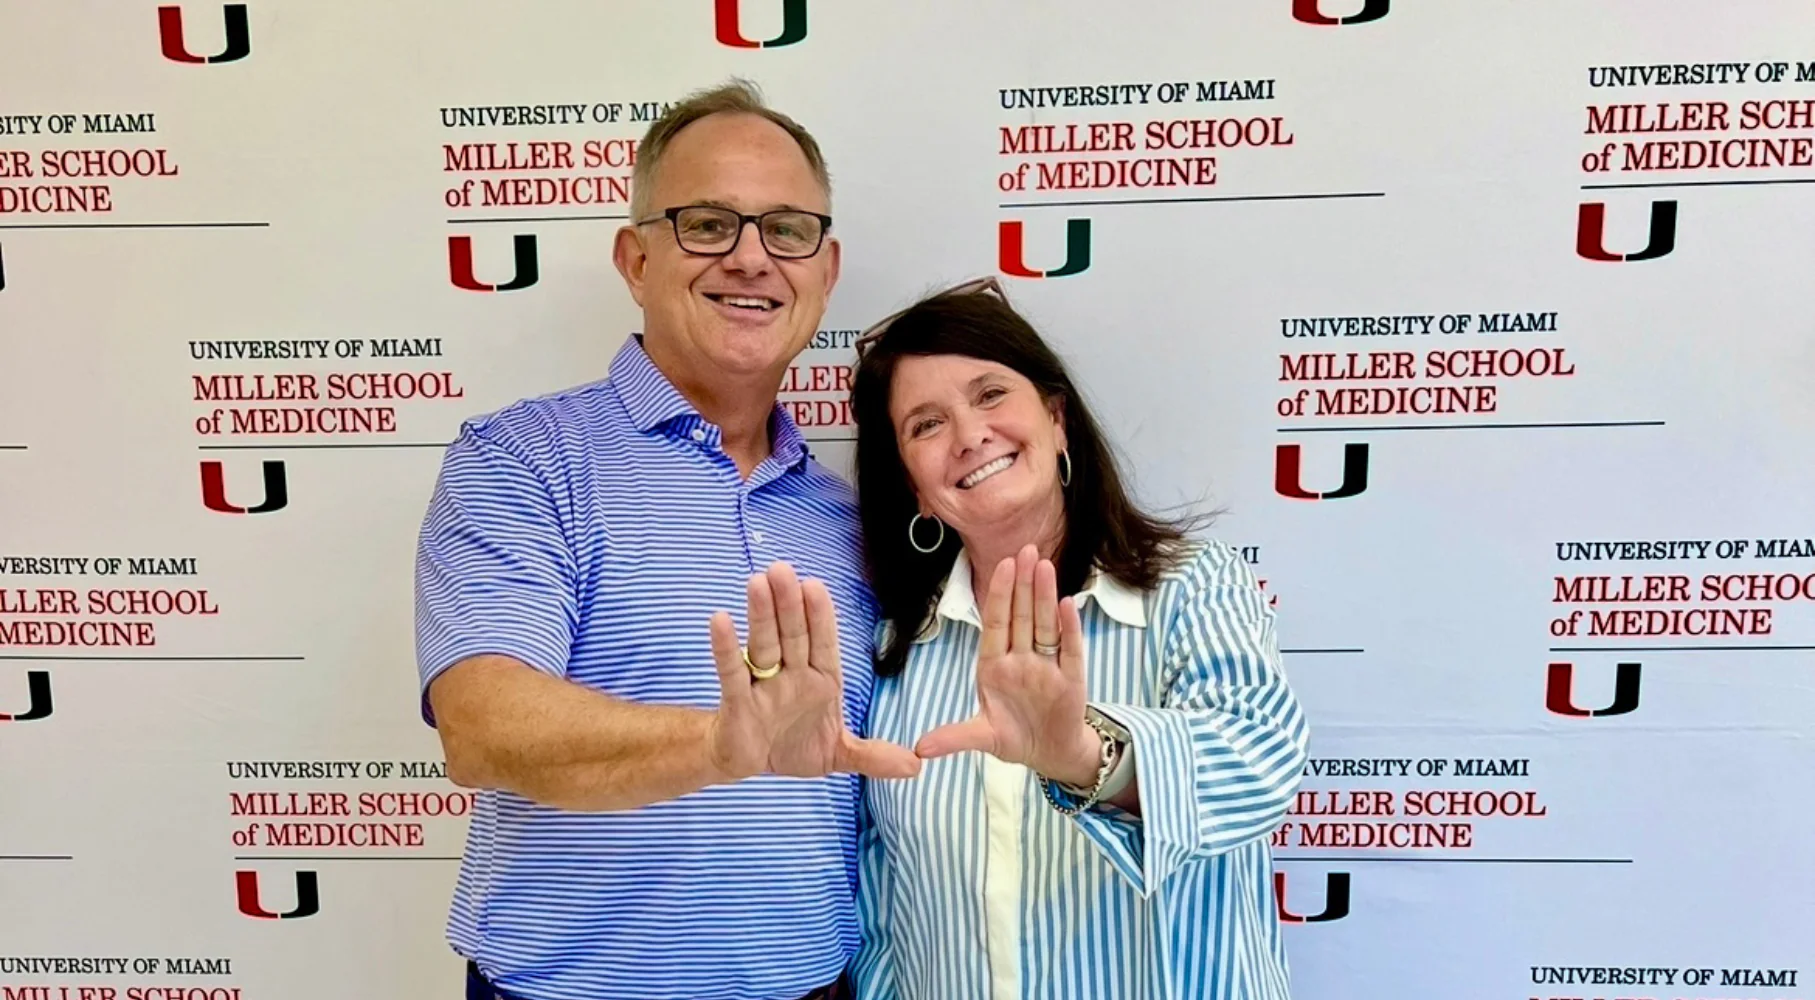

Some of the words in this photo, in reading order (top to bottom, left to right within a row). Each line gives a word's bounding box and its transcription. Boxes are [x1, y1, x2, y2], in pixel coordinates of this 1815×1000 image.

[1589, 63, 1750, 87] UNIVERSITY
[1755, 63, 1789, 82] OF
[999, 84, 1153, 109] UNIVERSITY
[1157, 83, 1189, 103] OF
[1196, 80, 1275, 102] MIAMI
[48, 115, 76, 133] OF
[82, 114, 155, 133] MIAMI
[440, 105, 587, 127] UNIVERSITY
[593, 104, 622, 123] OF
[1584, 102, 1729, 134] MILLER
[1740, 100, 1815, 130] SCH
[1000, 123, 1135, 154] MILLER
[1146, 117, 1293, 149] SCHOOL
[42, 150, 177, 177] SCHOOL
[443, 142, 574, 171] MILLER
[1582, 143, 1616, 172] of
[1621, 138, 1812, 170] MEDICINE
[999, 163, 1030, 191] of
[1037, 158, 1216, 189] MEDICINE
[0, 186, 111, 212] DICINE
[445, 180, 475, 207] of
[481, 177, 630, 206] MEDICIN
[1281, 316, 1435, 338] UNIVERSITY
[1439, 315, 1471, 334] OF
[1478, 313, 1558, 333] MIAMI
[189, 341, 329, 359] UNIVERSITY
[335, 340, 363, 358] OF
[370, 339, 442, 357] MIAMI
[1279, 352, 1416, 381] MILLER
[1426, 349, 1574, 378] SCHOOL
[192, 375, 319, 400] MILLER
[328, 372, 462, 399] SCHOOL
[1278, 389, 1309, 416] of
[1315, 386, 1496, 415] MEDICINE
[196, 409, 223, 434] of
[230, 408, 396, 433] MEDICINE
[1556, 541, 1711, 560] UNIVERSITY
[1716, 540, 1748, 558] OF
[0, 557, 88, 574] VERSITY
[94, 558, 121, 575] OF
[128, 558, 197, 575] MIAMI
[0, 589, 80, 614] LLER
[88, 590, 218, 614] SCHOOL
[1553, 576, 1691, 602] MILLER
[1550, 610, 1583, 636] of
[1588, 609, 1771, 636] MEDICINE
[227, 762, 361, 778] UNIVERSITY
[366, 762, 393, 778] OF
[399, 762, 447, 778] MIA
[1417, 759, 1447, 776] OF
[1453, 760, 1529, 776] MIAMI
[230, 793, 351, 816] MILLER
[1286, 791, 1395, 815] ILLER
[1404, 791, 1546, 816] SCHOOL
[233, 823, 259, 846] of
[265, 824, 424, 846] MEDICINE
[1298, 823, 1471, 847] MEDICINE
[0, 958, 129, 973] UNIVERSITY
[133, 958, 160, 974] OF
[165, 959, 231, 974] MIAMI
[1531, 967, 1679, 985] UNIVERSITY
[1683, 969, 1714, 985] OF
[1720, 969, 1797, 987] MIAMI
